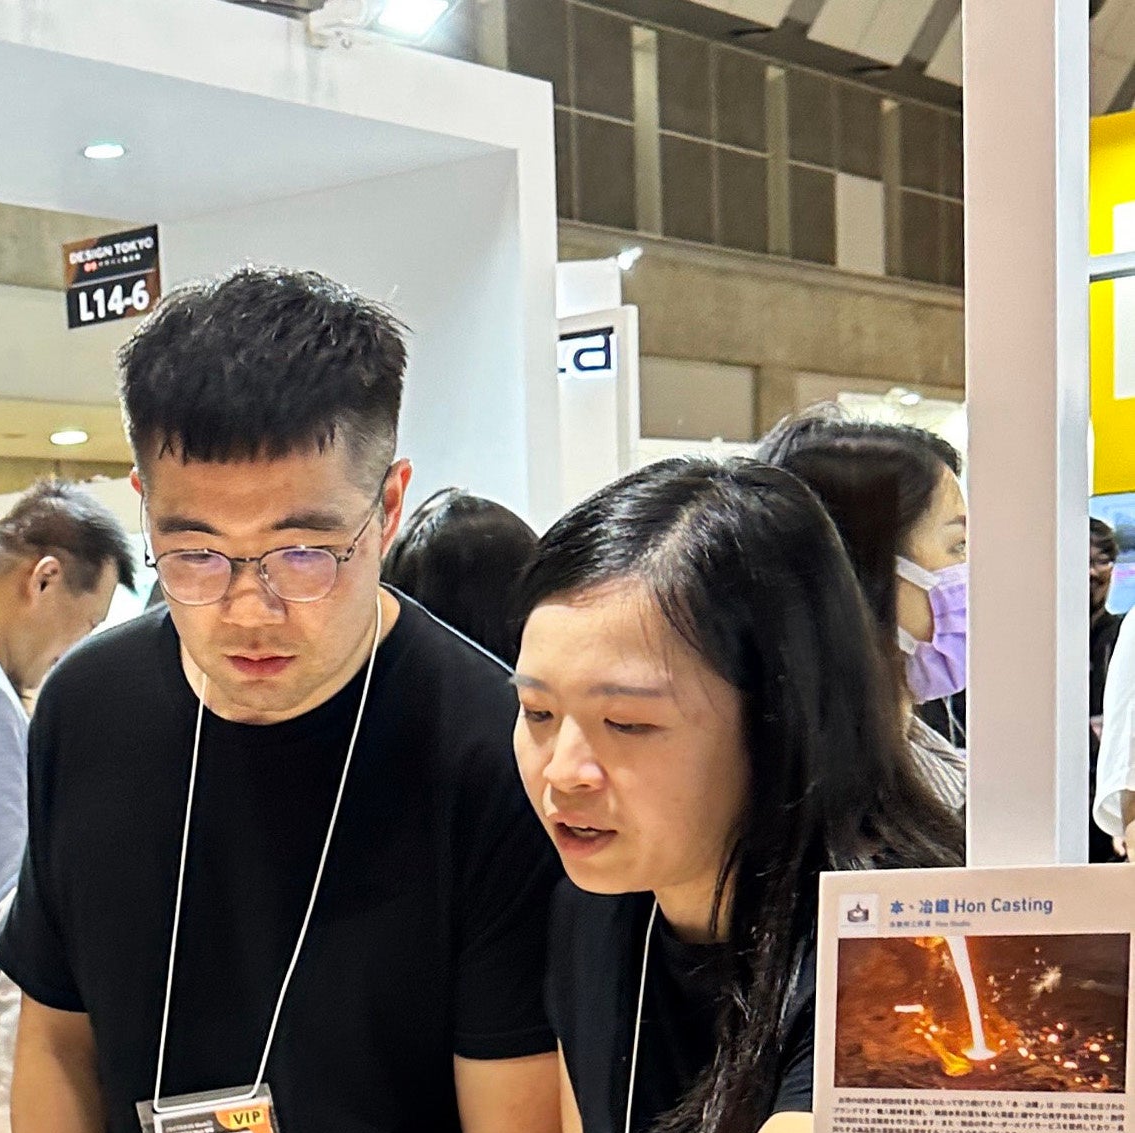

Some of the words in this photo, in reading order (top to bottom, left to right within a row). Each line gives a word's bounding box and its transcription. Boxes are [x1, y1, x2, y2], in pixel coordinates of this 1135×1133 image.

[113, 235, 154, 256] TOKYO
[78, 279, 150, 322] L14-6
[558, 325, 616, 374] a
[954, 899, 986, 913] Hon
[991, 897, 1054, 915] Casting
[232, 1110, 262, 1126] VIP
